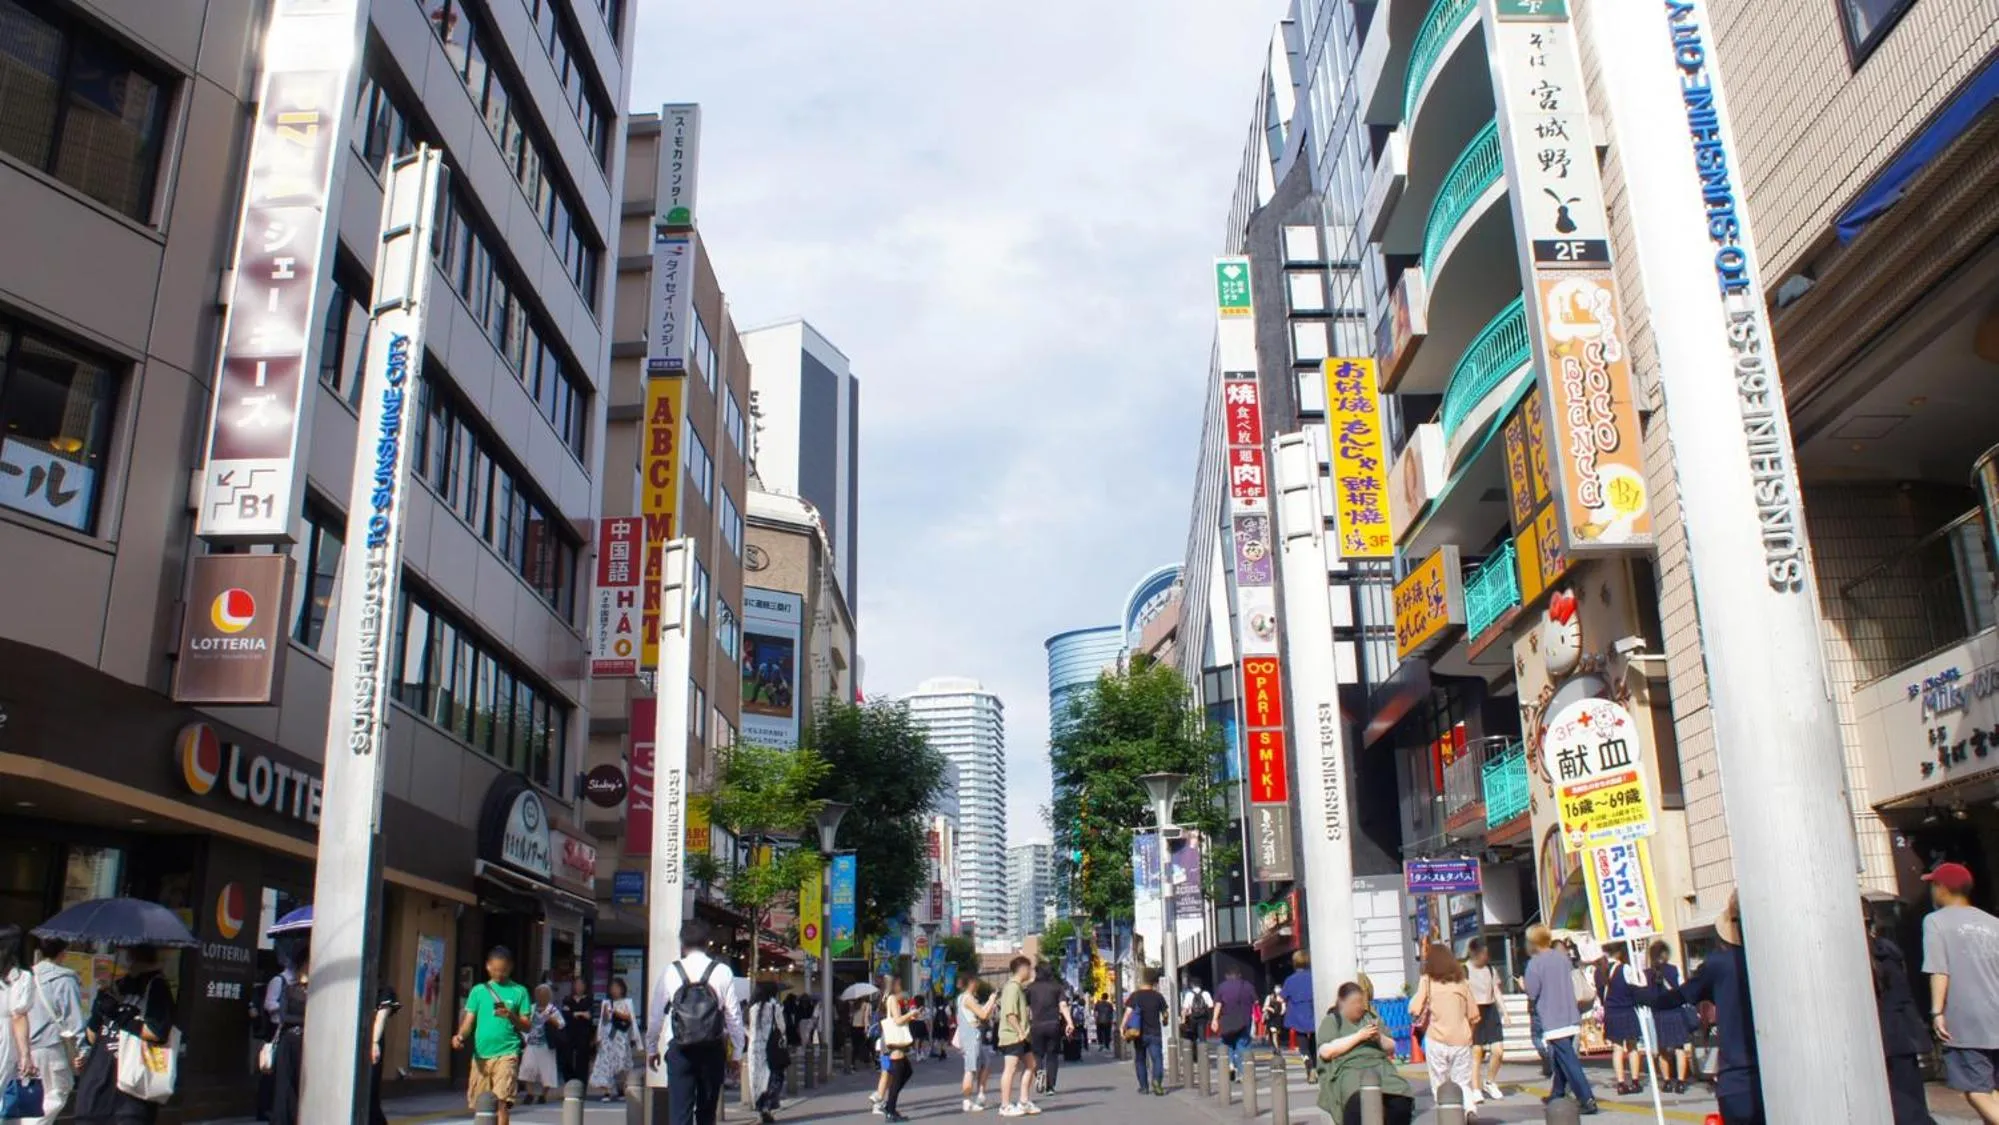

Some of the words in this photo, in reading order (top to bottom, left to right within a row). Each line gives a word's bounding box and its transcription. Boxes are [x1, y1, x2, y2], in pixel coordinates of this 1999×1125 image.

[1531, 79, 1572, 179] 宮城野
[671, 116, 685, 206] スーモカウンター
[1680, 73, 1741, 243] SUNSHINE
[1555, 241, 1586, 261] 2F
[1715, 246, 1750, 291] TO
[661, 260, 678, 357] タイセイ・ハウジー
[371, 386, 404, 511] SUNSHINE
[239, 494, 275, 519] B1
[1610, 478, 1640, 513] B1
[367, 513, 389, 549] TO
[641, 397, 674, 645] ABC-MART
[1369, 535, 1389, 547] 3F
[608, 520, 632, 582] 中国語
[191, 638, 266, 650] LOTTERIA
[1256, 677, 1271, 745] PARIS
[1555, 721, 1577, 741] 3F
[1260, 748, 1273, 799] MIKI
[1556, 738, 1632, 781] 献血
[1611, 845, 1633, 895] アイス
[1602, 877, 1625, 937] クリーム
[202, 943, 250, 963] LOTTERIA
